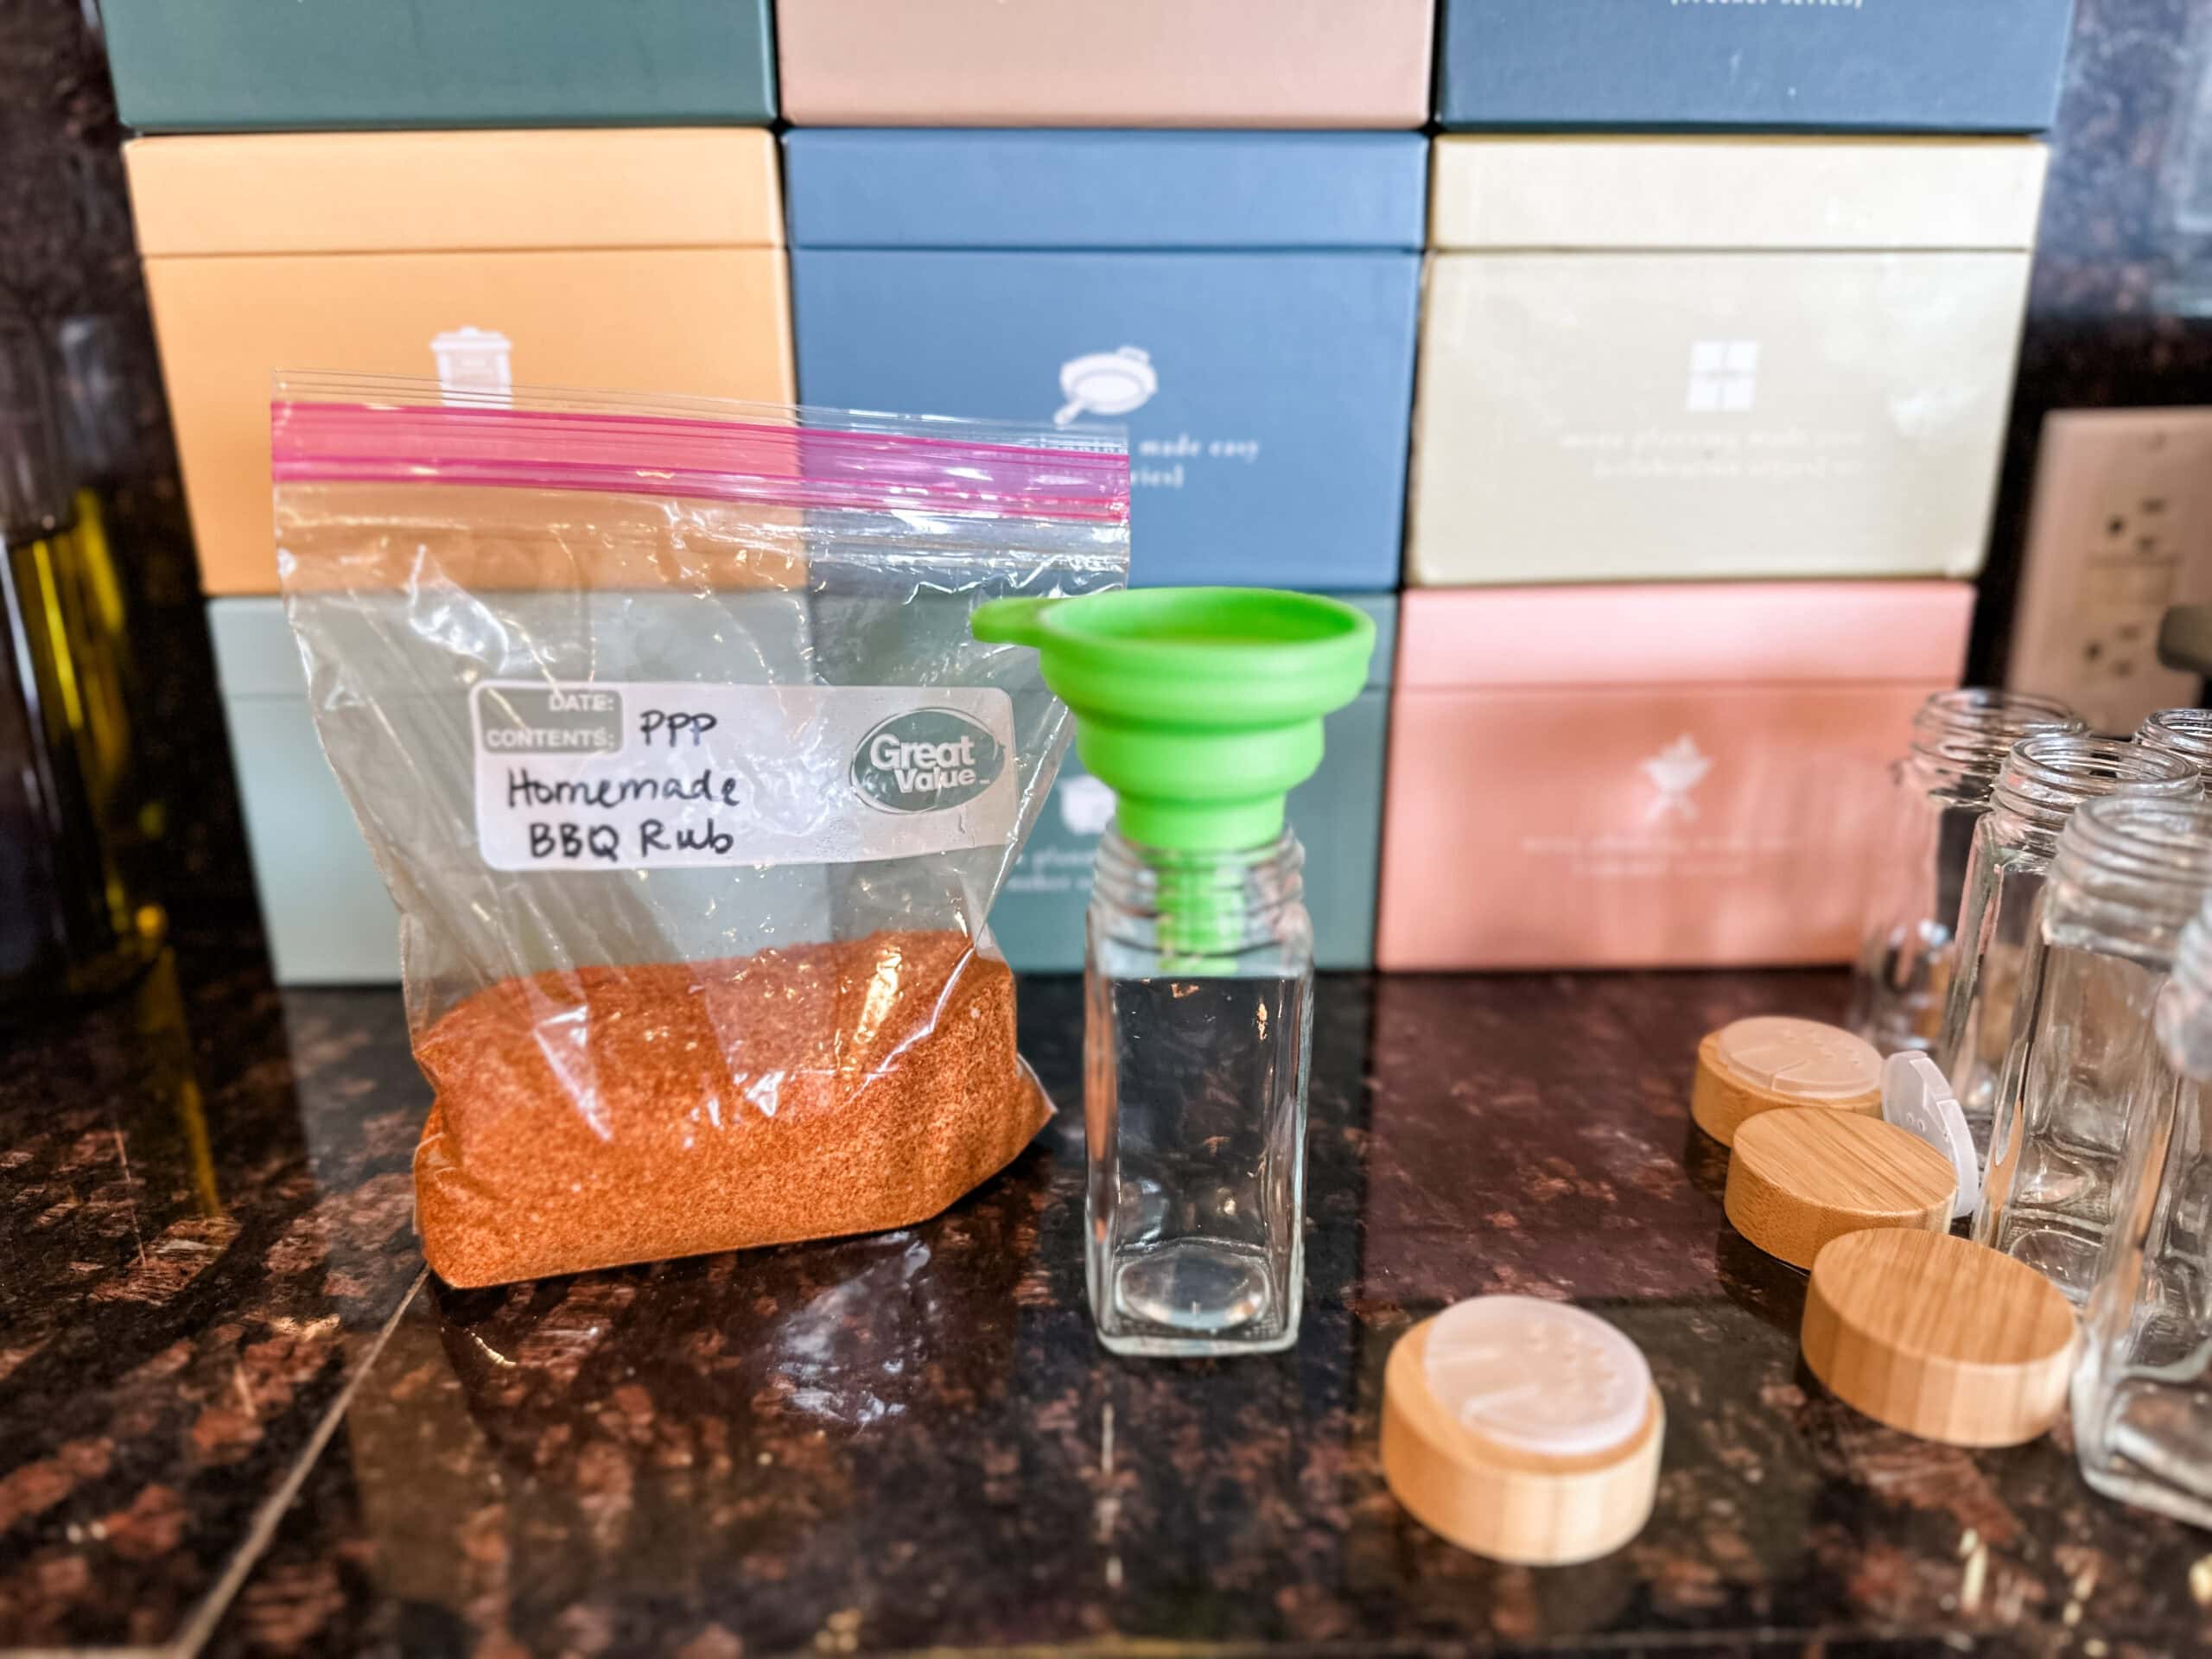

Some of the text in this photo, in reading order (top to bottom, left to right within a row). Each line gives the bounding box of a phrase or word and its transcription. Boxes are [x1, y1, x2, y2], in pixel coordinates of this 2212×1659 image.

[548, 692, 615, 712] DATE:
[486, 728, 616, 749] CONTENTS:
[640, 709, 718, 747] PPP
[869, 733, 976, 772] Great
[507, 766, 741, 810] Homemade
[893, 762, 977, 795] Value
[529, 817, 734, 863] BBQ Rub
